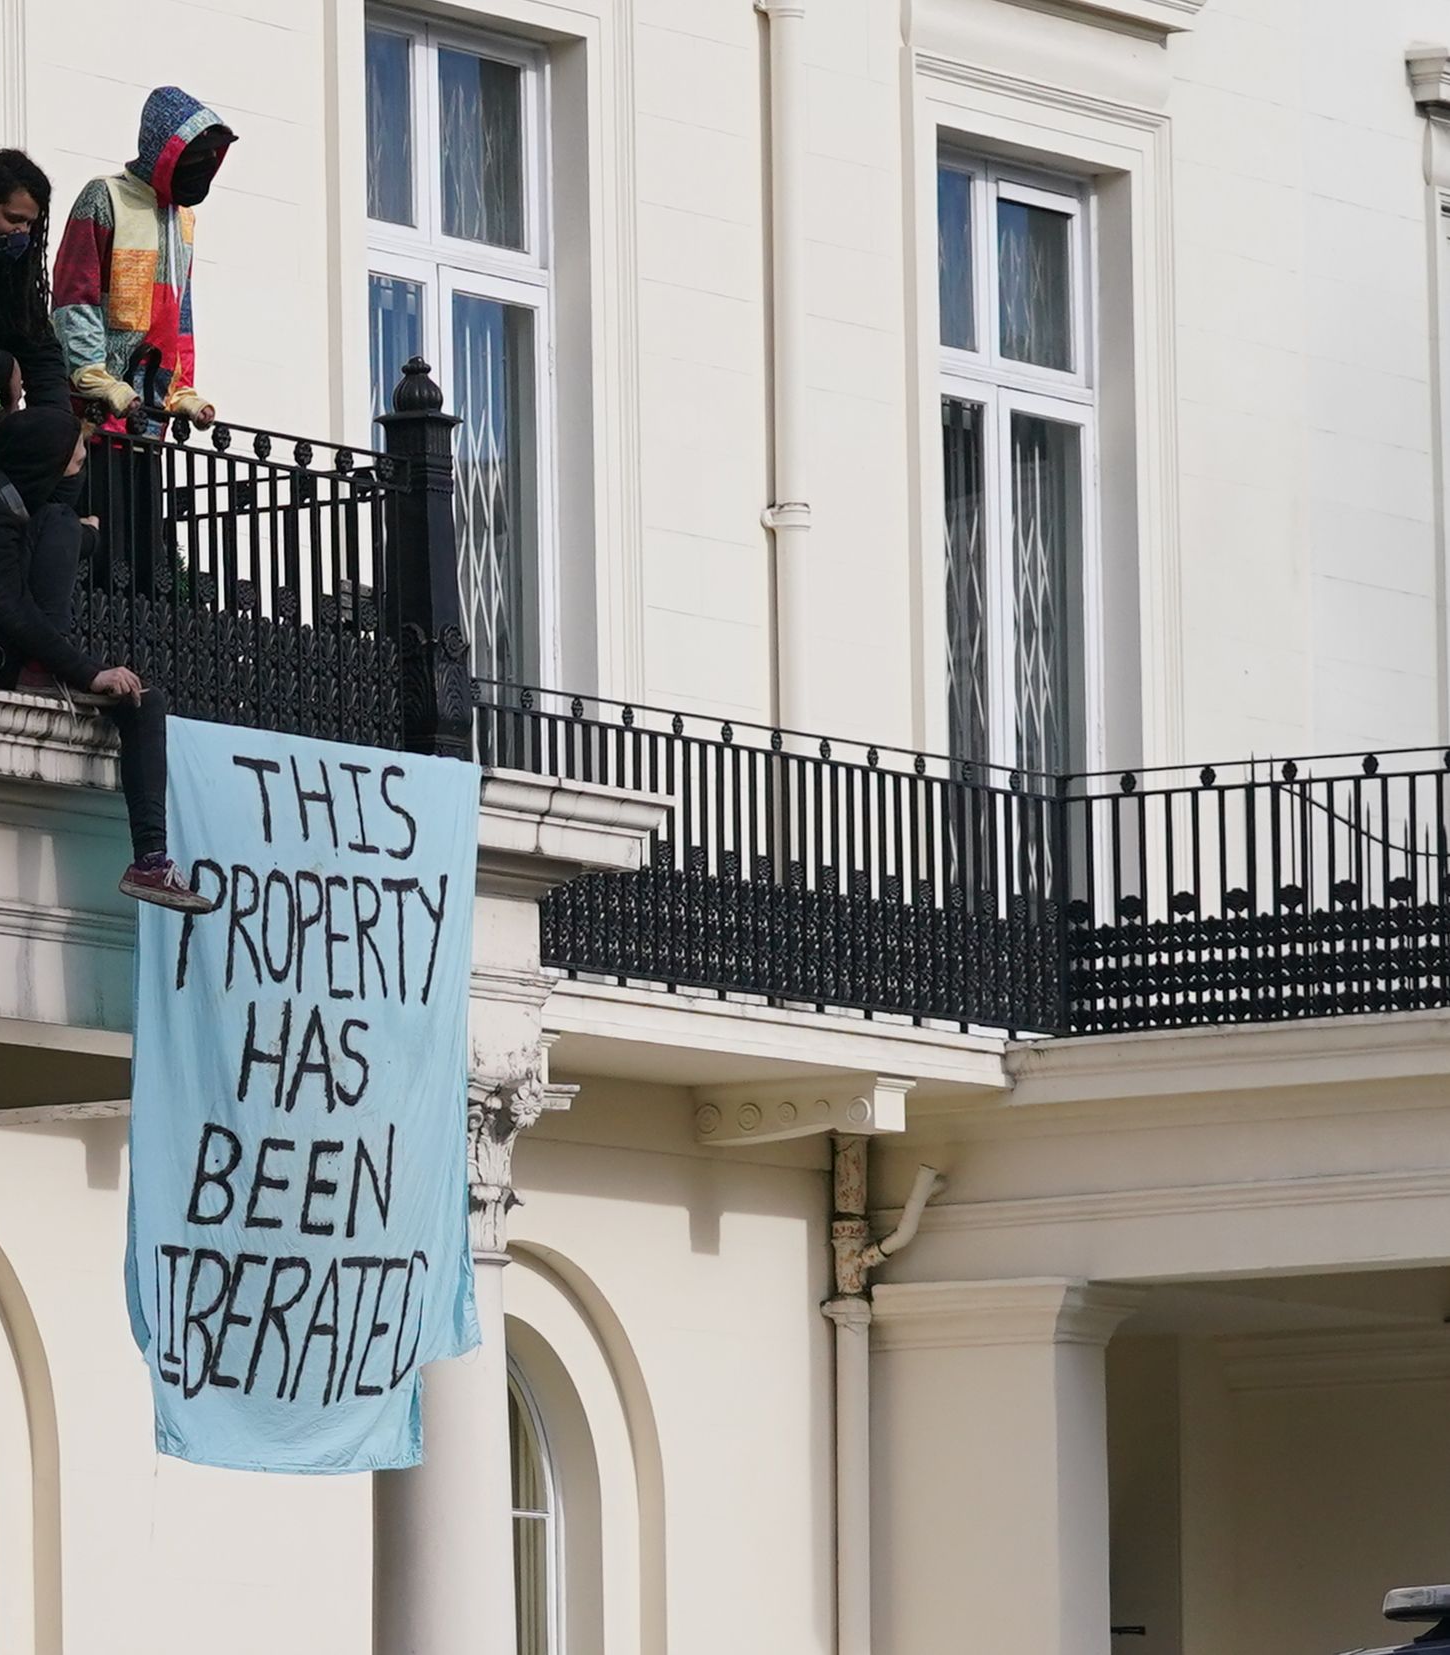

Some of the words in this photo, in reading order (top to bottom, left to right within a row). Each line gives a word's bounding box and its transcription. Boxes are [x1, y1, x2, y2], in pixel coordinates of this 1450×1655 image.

[232, 754, 417, 861] THIS
[175, 857, 449, 1006] PROPERTY
[236, 998, 370, 1115] HAS
[187, 1121, 396, 1239] BEEN
[154, 1244, 429, 1409] LIBERATED
